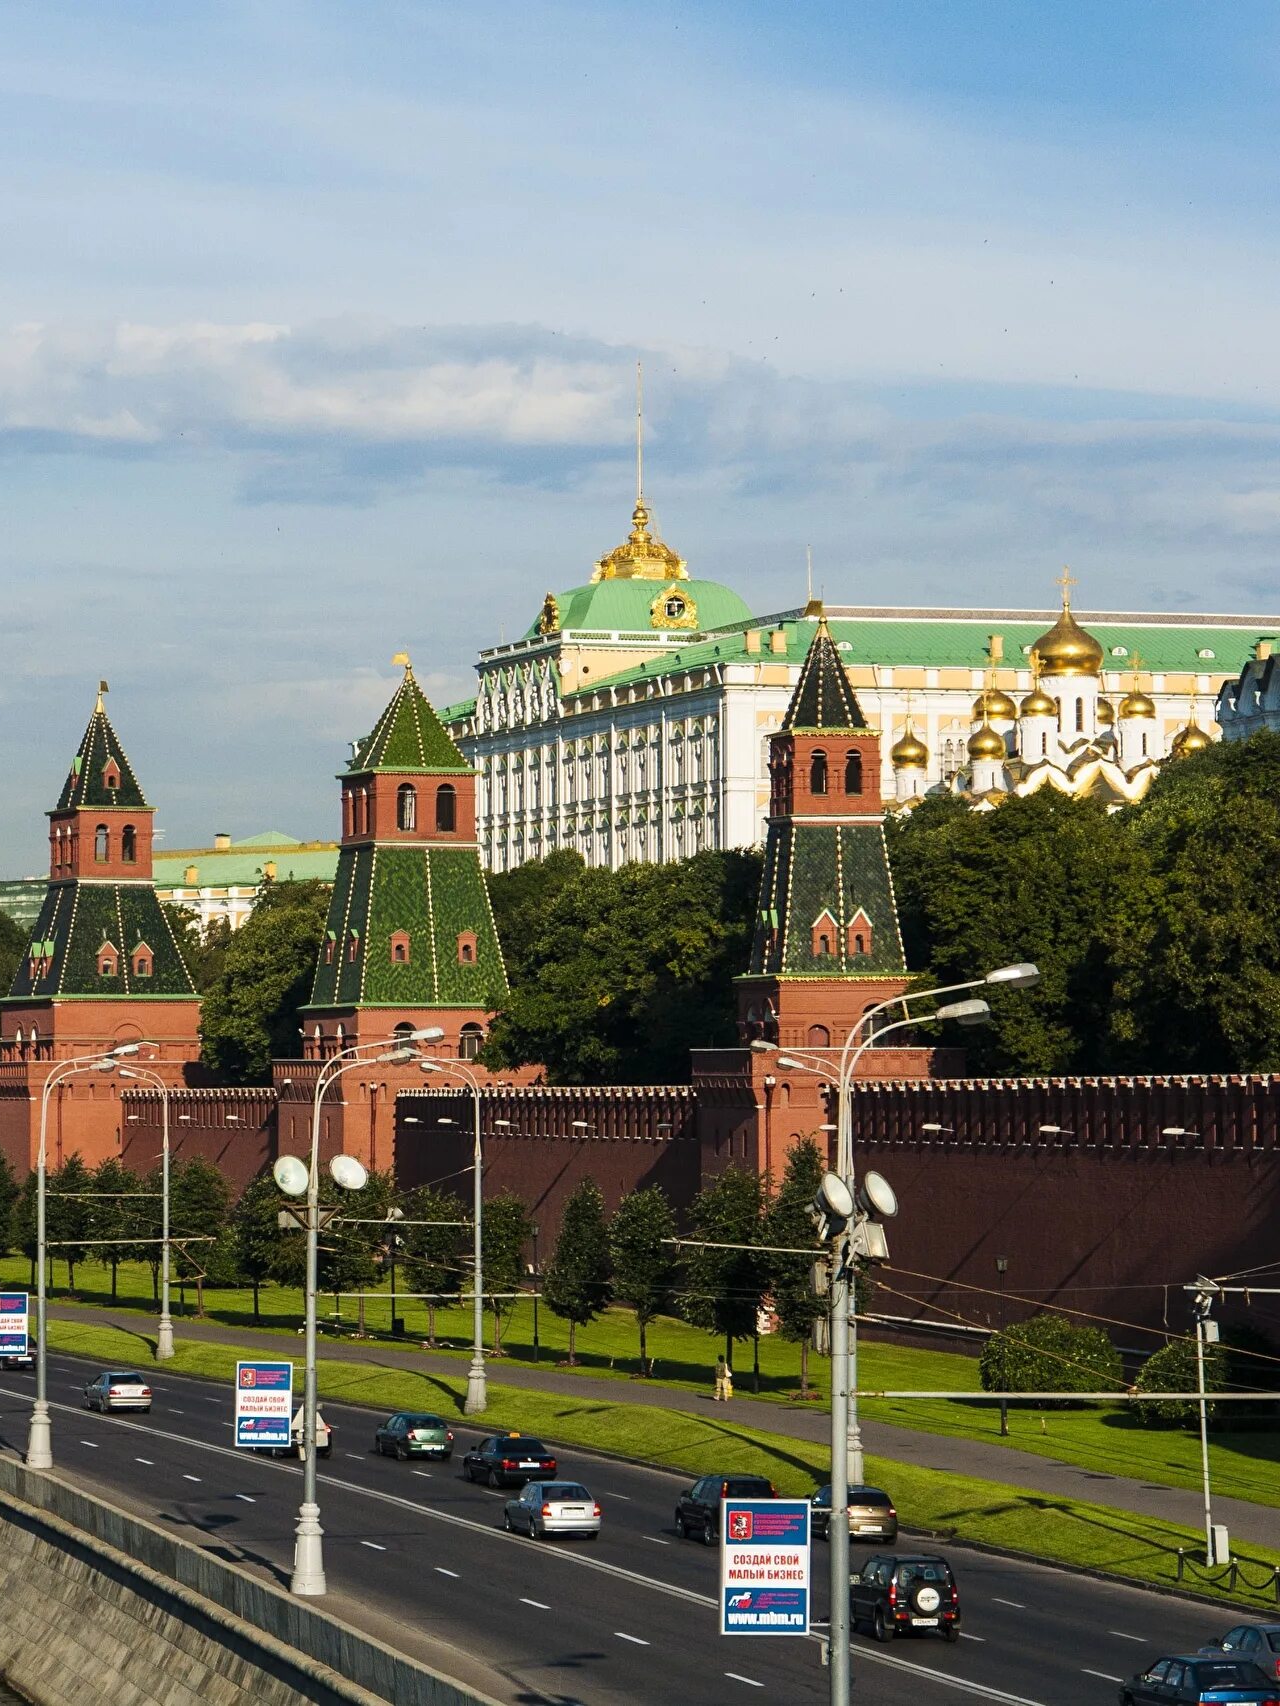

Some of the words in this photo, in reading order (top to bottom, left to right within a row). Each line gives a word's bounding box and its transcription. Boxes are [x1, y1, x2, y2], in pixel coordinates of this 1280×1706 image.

[243, 1395, 268, 1404] СОЗДАЙ
[268, 1395, 285, 1403] СВОЙ
[240, 1405, 264, 1413] МАЛЫЙ
[264, 1405, 288, 1413] БИЗНЕС
[733, 1553, 772, 1567] СОЗДАЙ
[773, 1553, 800, 1566] СВОЙ
[728, 1568, 765, 1580] МАЛЫЙ
[767, 1569, 804, 1580] БИЗНЕС
[728, 1611, 804, 1626] www.mbm.ru
